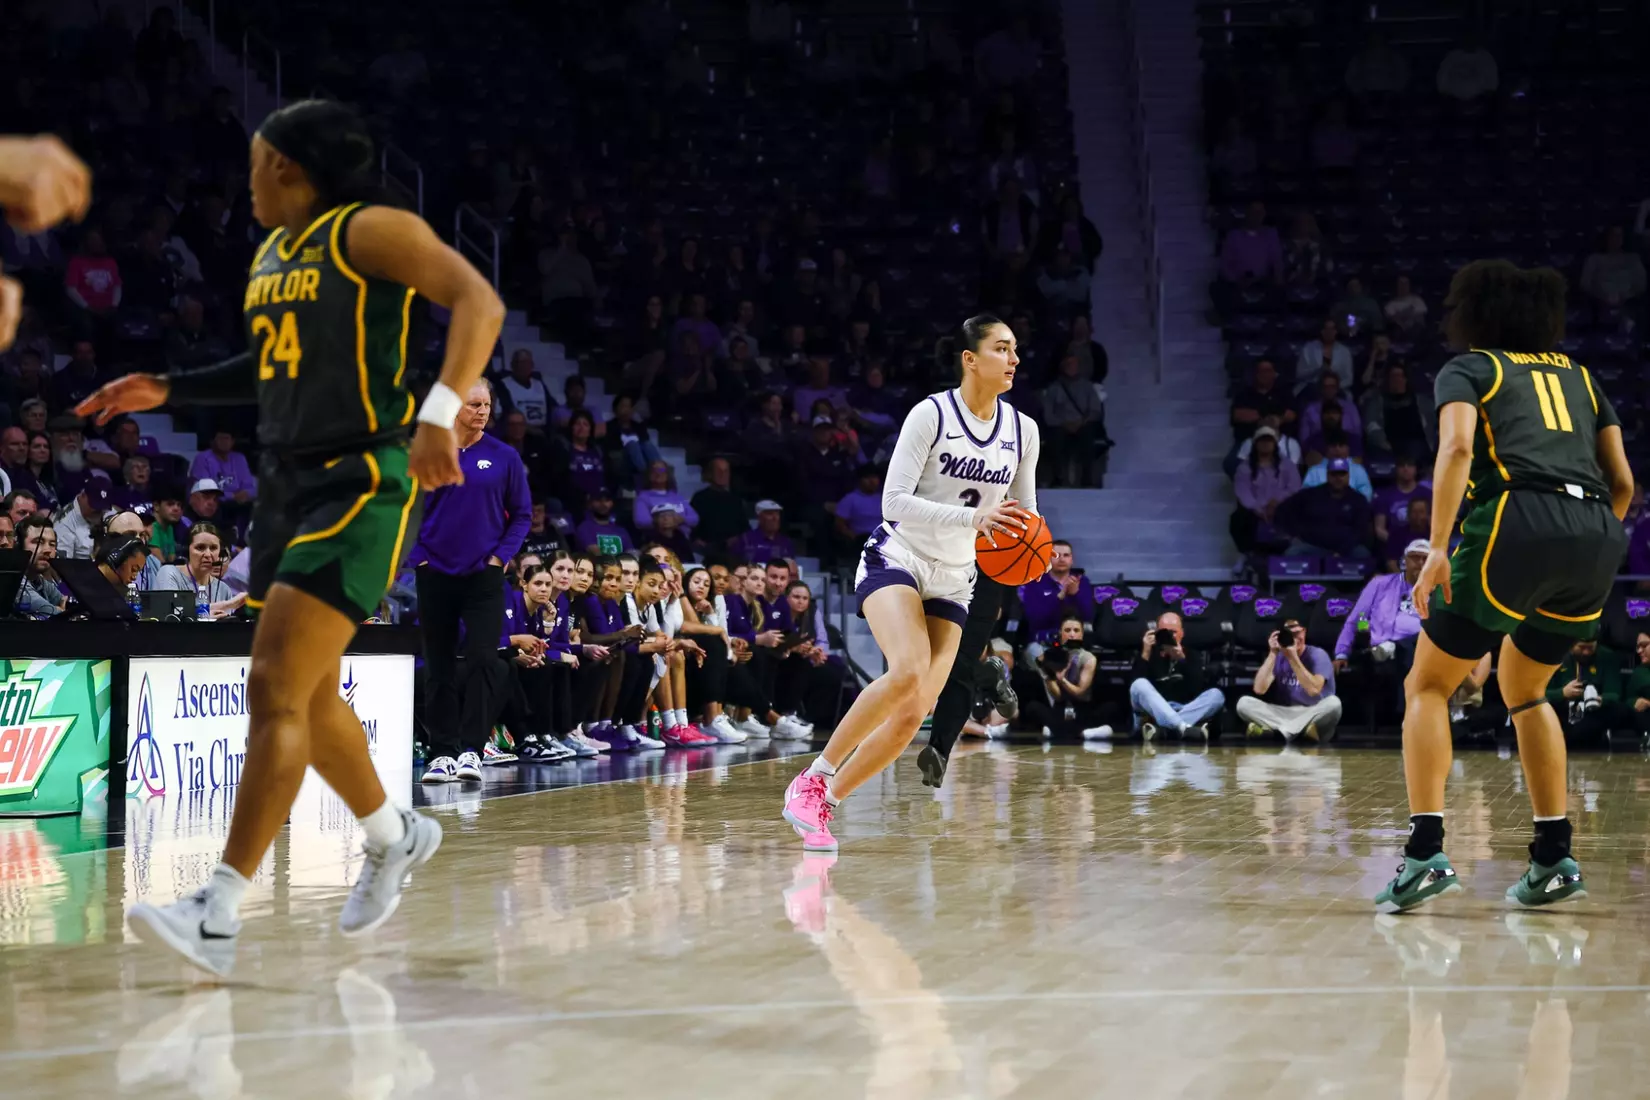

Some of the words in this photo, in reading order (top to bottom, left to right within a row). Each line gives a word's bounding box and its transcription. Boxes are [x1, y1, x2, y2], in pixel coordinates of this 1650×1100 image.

[244, 268, 320, 311] AYLOR
[252, 311, 302, 381] 24
[1503, 351, 1572, 370] WALKER
[1531, 370, 1573, 432] 11
[939, 452, 1011, 485] Wildcats
[0, 682, 32, 727] tn
[173, 667, 251, 719] Ascensi
[173, 741, 205, 792] Via
[209, 737, 248, 790] Chr
